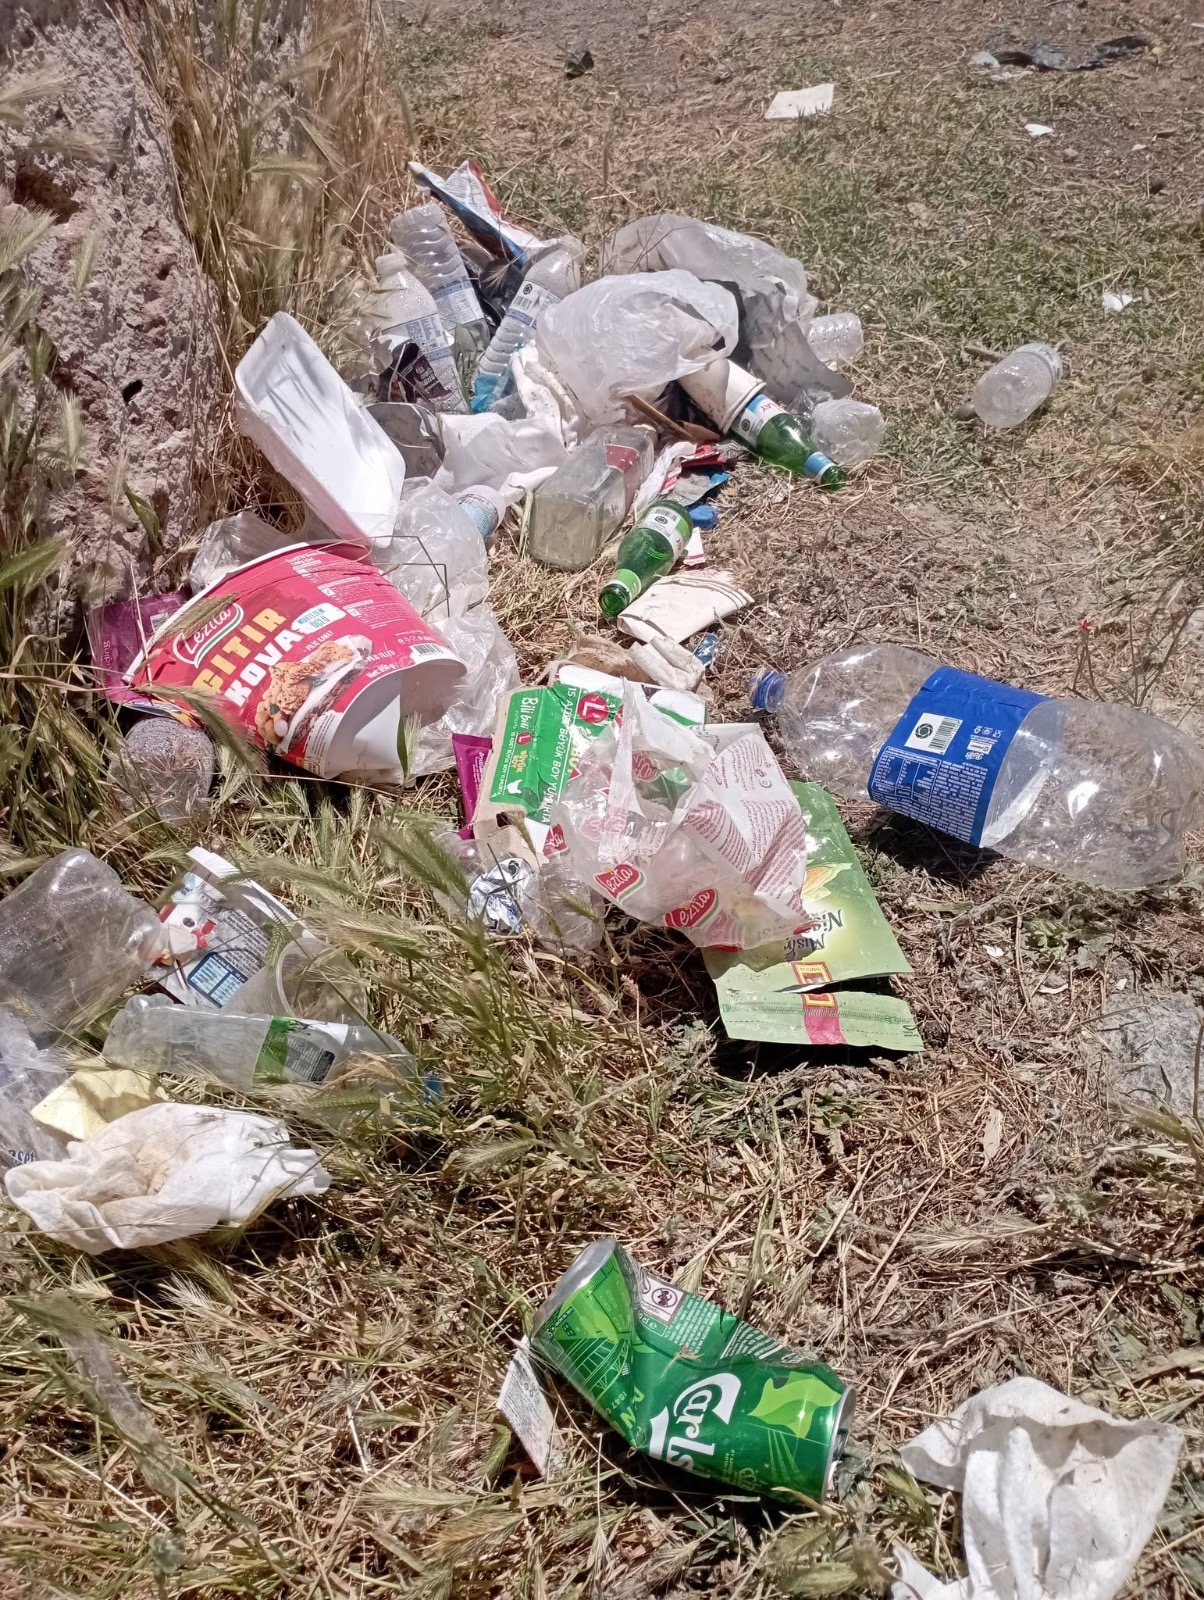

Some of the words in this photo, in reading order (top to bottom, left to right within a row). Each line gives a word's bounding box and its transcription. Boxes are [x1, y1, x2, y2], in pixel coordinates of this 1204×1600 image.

[224, 629, 304, 707] KOVA
[567, 687, 577, 698] 15
[520, 697, 539, 715] Bili
[582, 701, 606, 717] L
[520, 714, 533, 730] bili
[554, 728, 568, 759] BÜYÜK
[551, 760, 562, 780] BOY
[541, 782, 557, 823] YUMURTA
